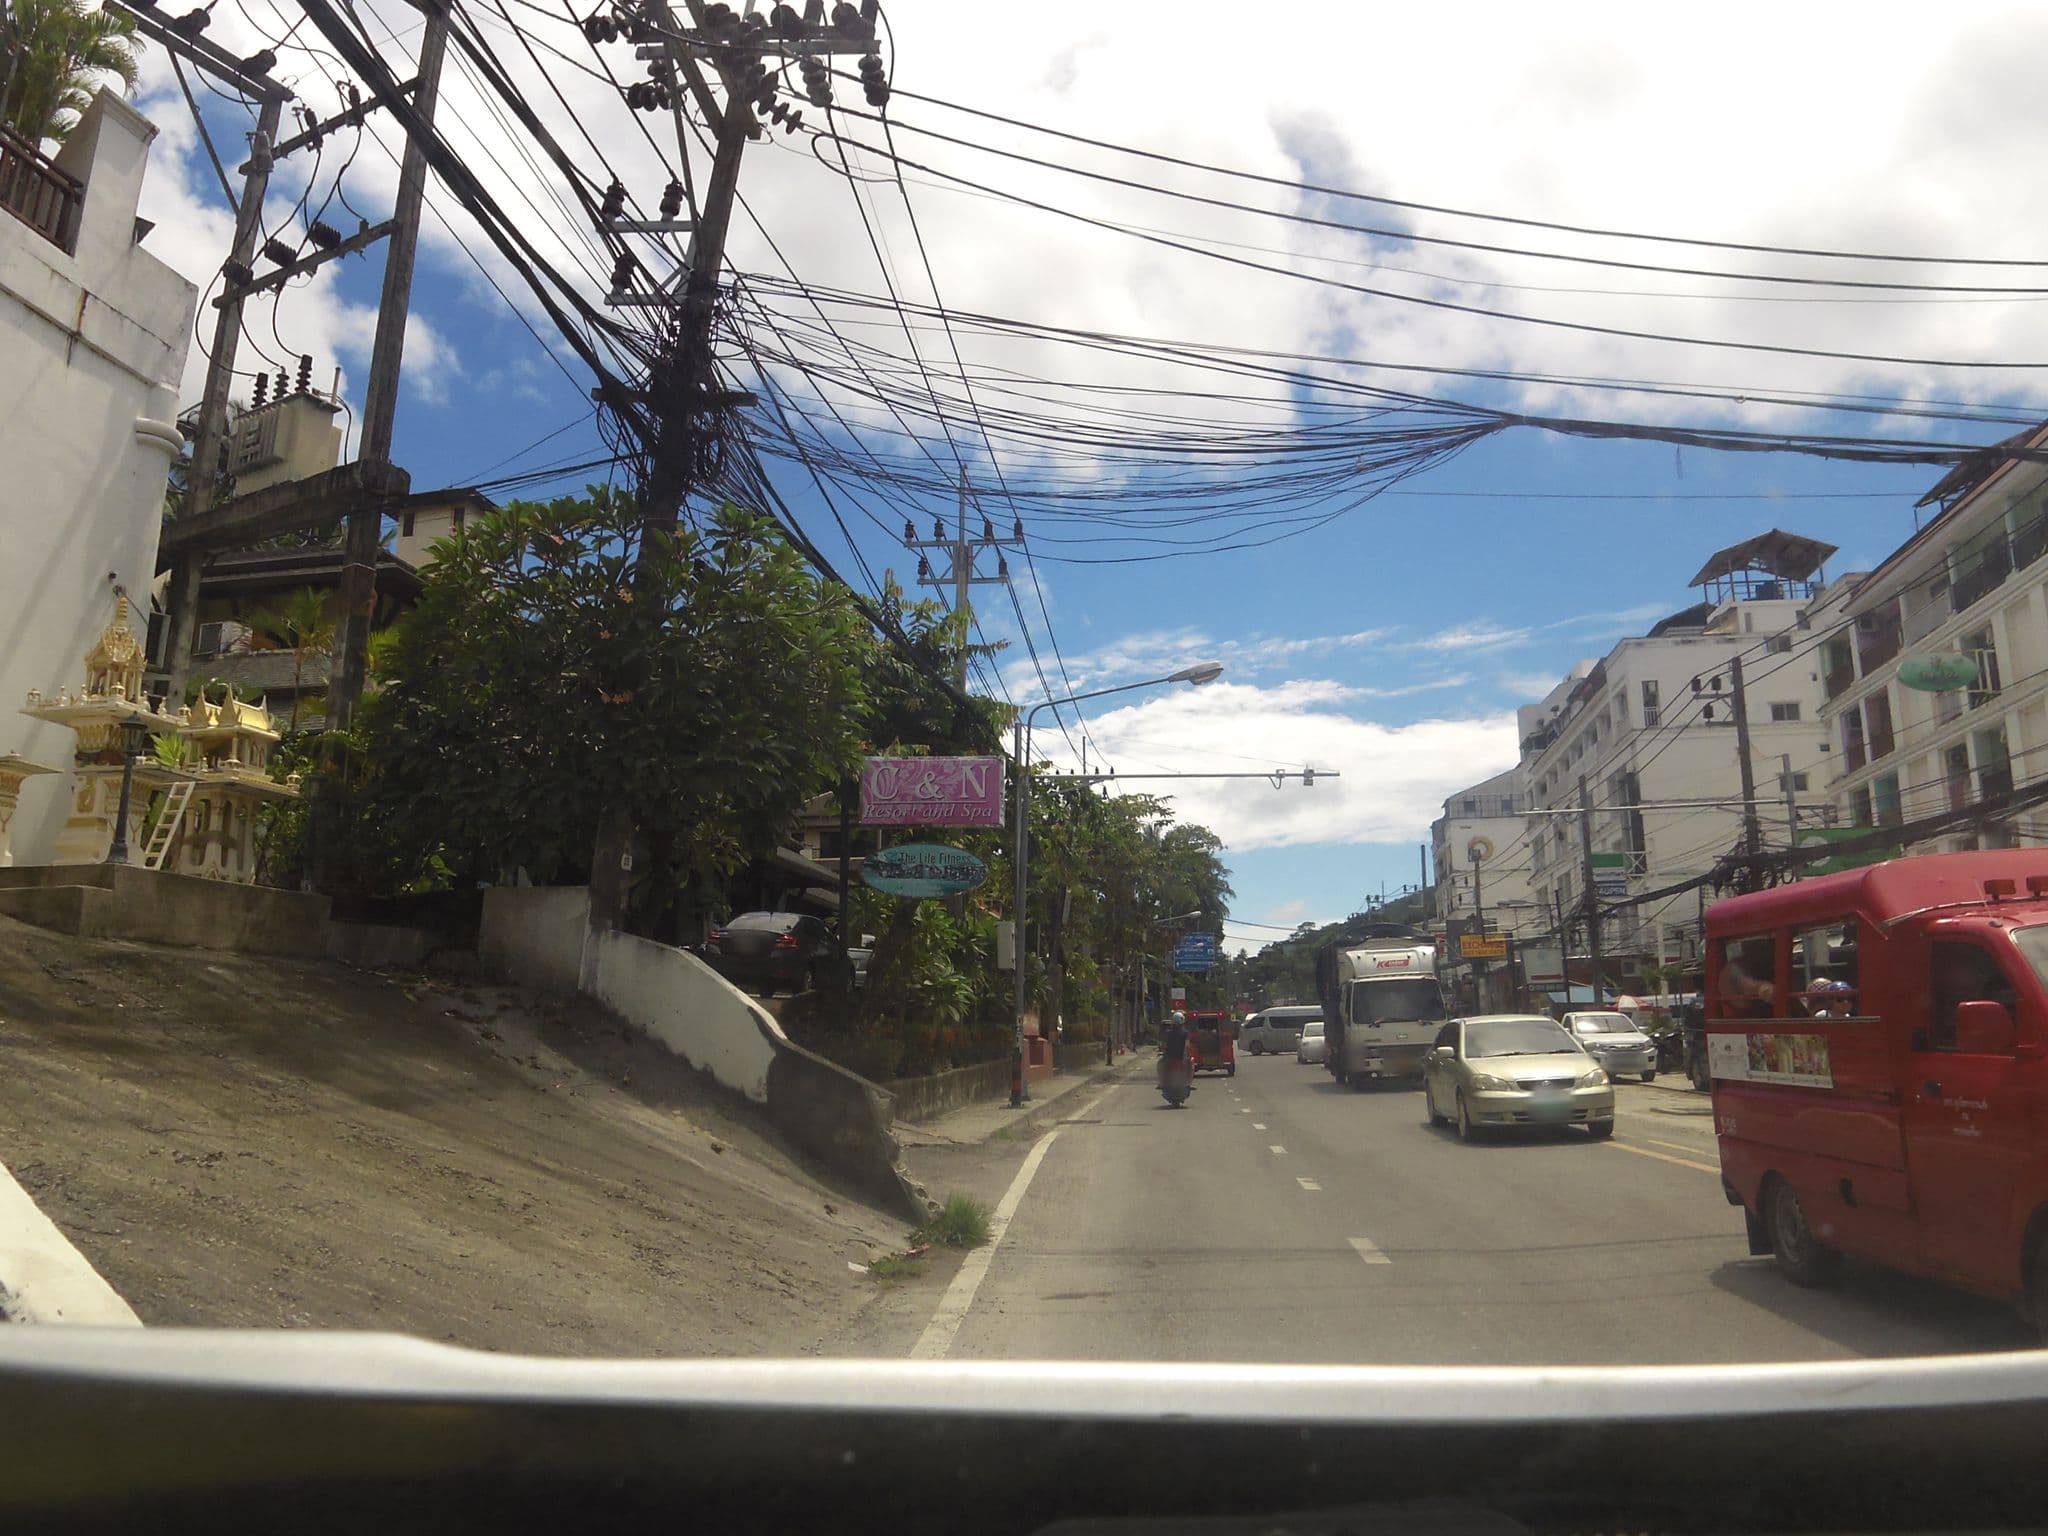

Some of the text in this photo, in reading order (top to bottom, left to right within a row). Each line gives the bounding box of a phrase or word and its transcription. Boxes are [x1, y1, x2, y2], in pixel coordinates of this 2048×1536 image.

[869, 765, 991, 800] C & N
[863, 802, 993, 821] Resort and Spa
[900, 853, 916, 864] The
